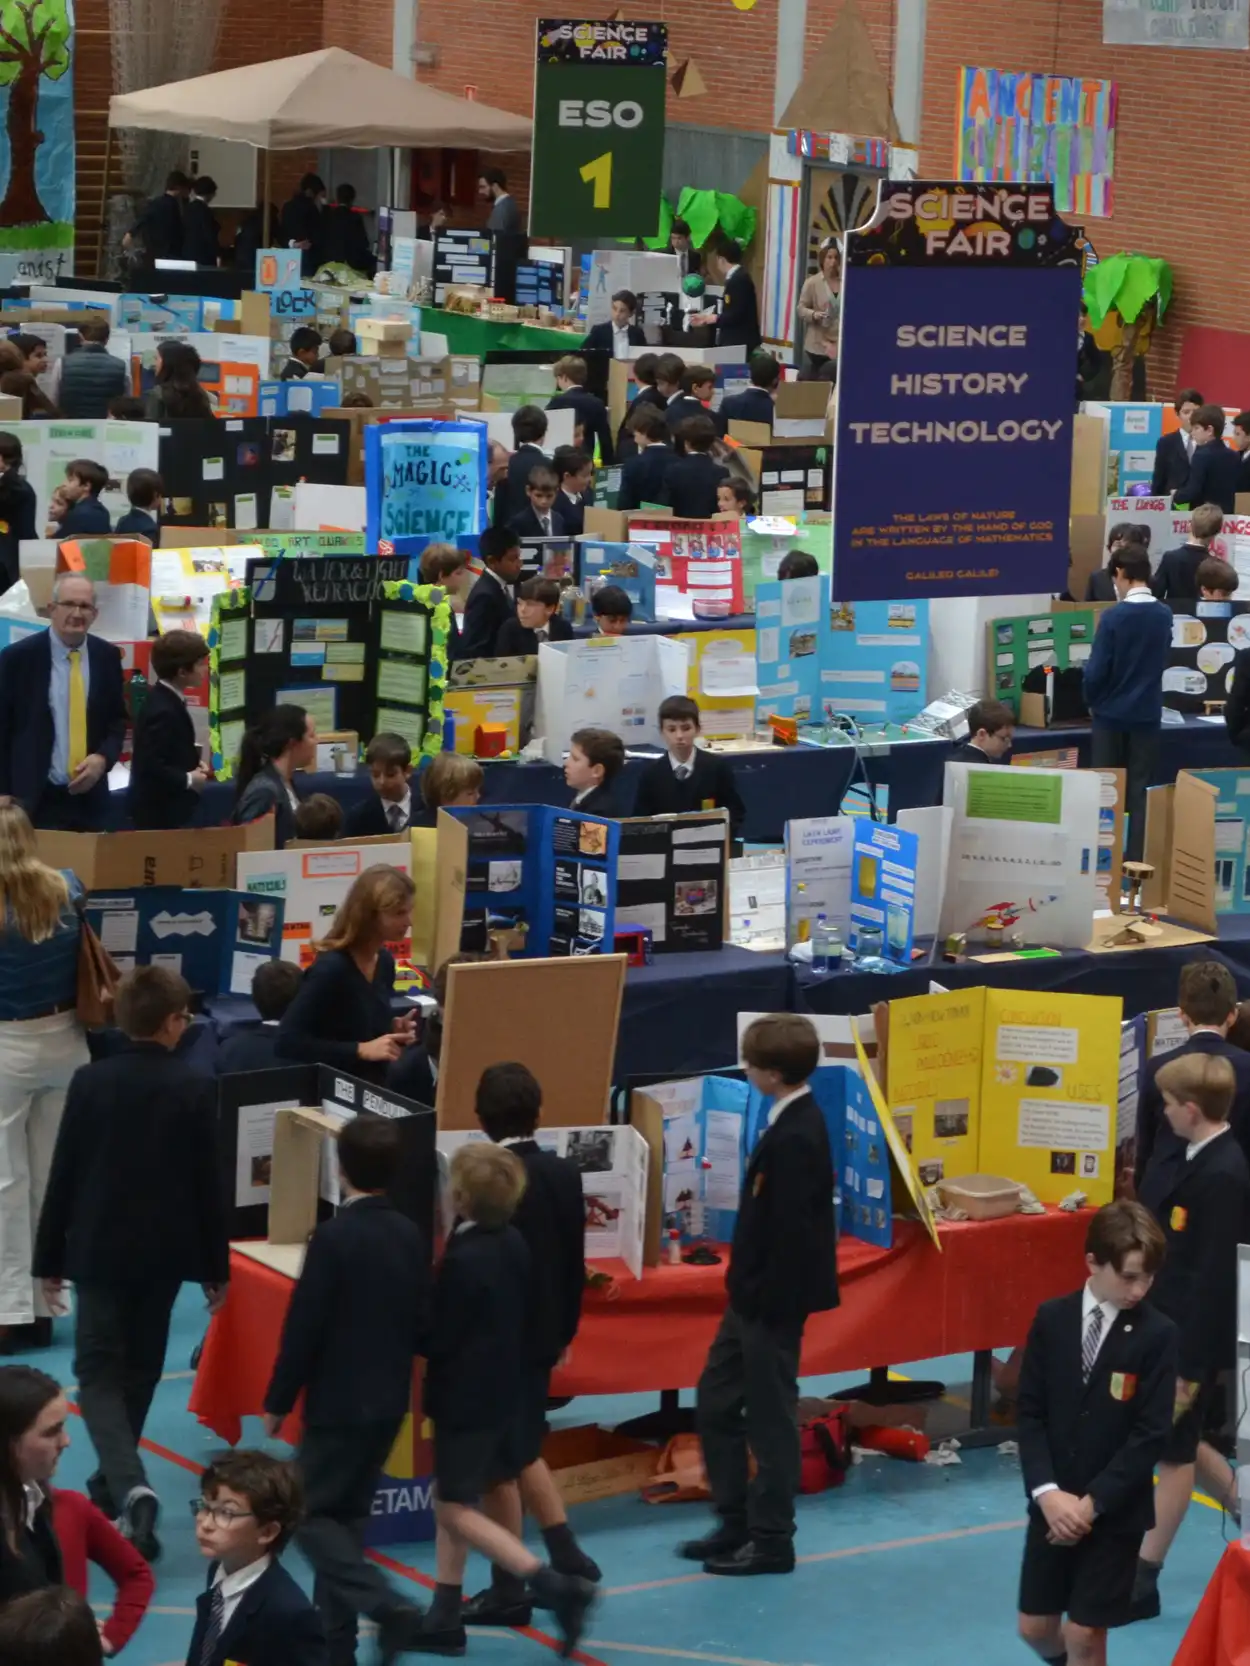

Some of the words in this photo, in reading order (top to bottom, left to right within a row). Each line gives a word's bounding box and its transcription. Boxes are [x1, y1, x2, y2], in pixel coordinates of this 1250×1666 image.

[559, 24, 648, 42] SCIENCE
[579, 45, 628, 60] FAIR
[558, 100, 644, 128] ESO
[579, 150, 613, 209] 1
[887, 192, 1051, 221] SCIENCE
[925, 230, 1012, 256] FAIR
[895, 325, 1029, 348] SCIENCE
[890, 372, 1029, 396] HISTORY
[848, 418, 1064, 445] TECHNOLOGY
[404, 445, 431, 457] THE
[391, 459, 452, 489] MAGIC
[892, 513, 915, 523] THE
[918, 512, 949, 523] LAWS
[952, 511, 968, 522] OF
[971, 510, 1017, 521] NATURE
[1111, 499, 1129, 511] THE
[1135, 498, 1166, 512] LUNGS
[384, 502, 470, 540] SCIENCE
[851, 526, 875, 536] ARE
[879, 525, 930, 535] WRITTEN
[932, 524, 948, 534] BY
[951, 523, 973, 533] THE
[976, 522, 1010, 532] HAND
[1011, 521, 1027, 531] OF
[1029, 520, 1054, 531] GOD
[851, 538, 863, 548] IN
[867, 537, 889, 547] THE
[892, 535, 954, 546] LANGUAGE
[957, 534, 972, 544] OF
[975, 532, 1054, 543] MATHEMATICS
[905, 570, 954, 581] GALILEO
[956, 568, 1000, 580] GALILEI
[369, 1485, 434, 1515] ETAM
